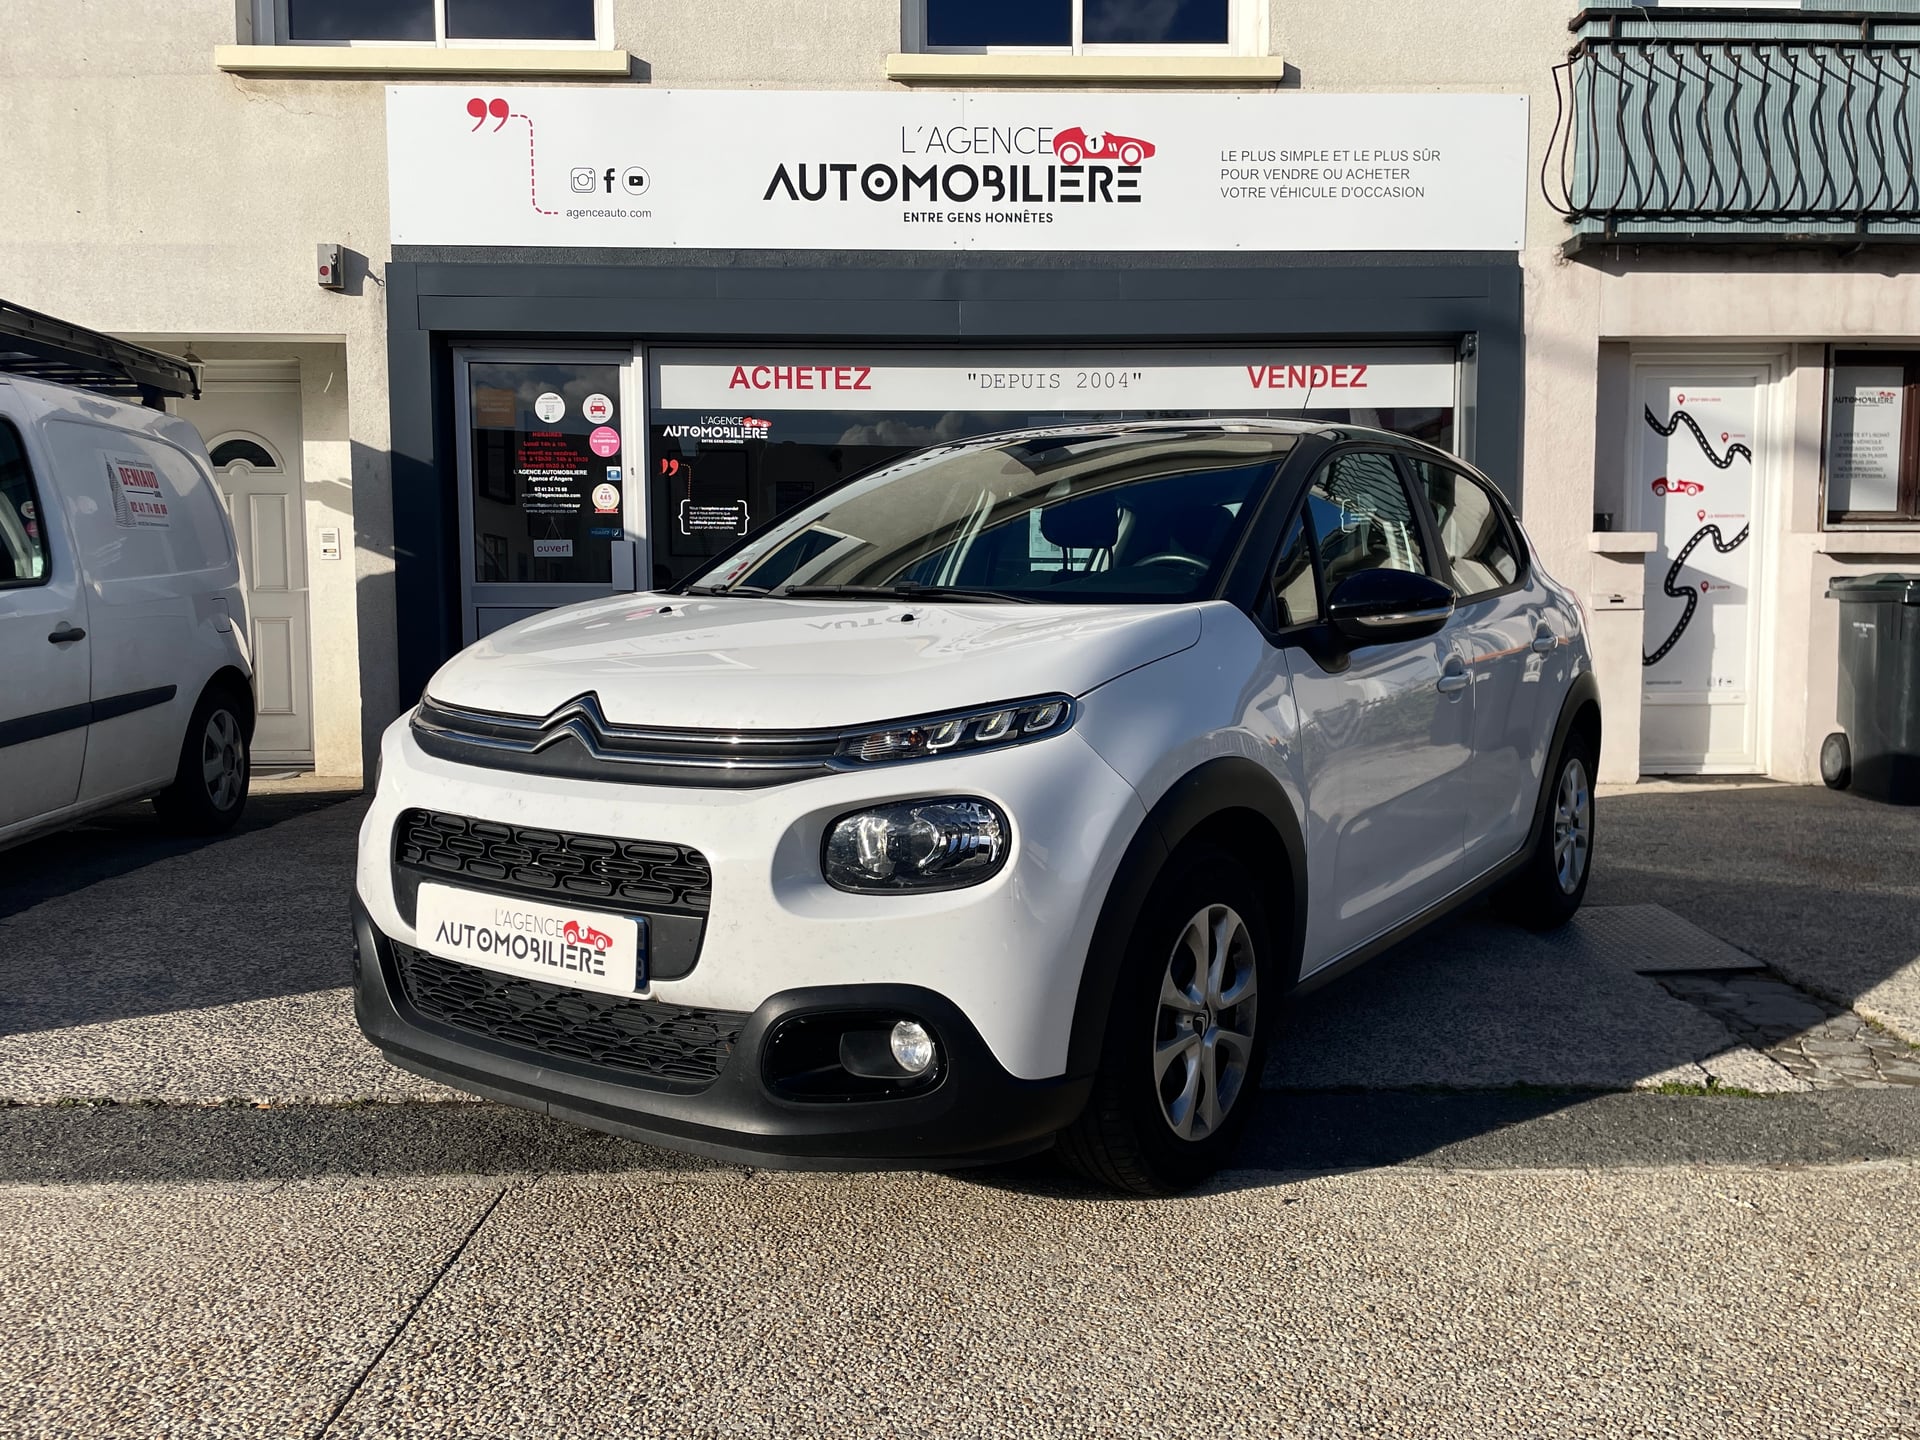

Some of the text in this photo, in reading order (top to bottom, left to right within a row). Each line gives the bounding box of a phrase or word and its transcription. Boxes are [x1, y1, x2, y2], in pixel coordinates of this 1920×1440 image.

[902, 126, 1053, 155] L'AGENCE
[1221, 146, 1441, 162] LE PLUS SIMPLE ET LE PLUS SÛR
[763, 163, 1142, 203] AUTOMOBILIERE
[1221, 168, 1410, 181] POUR VENDRE OU ACHETER
[1221, 184, 1425, 199] VOTRE VÉHICULE D'OCCASION
[566, 208, 652, 220] agenceauto.com
[903, 209, 1053, 224] ENTRE GENS HONNÊTES
[729, 365, 872, 390] ACHETEZ
[1247, 365, 1368, 388] VENDEZ
[701, 416, 744, 426] L'AGENCE
[118, 467, 160, 489] DENIAUD
[536, 544, 569, 553] ouvert
[495, 908, 564, 938] L'AGENCE
[435, 920, 606, 976] AUTOMOBILIERE
